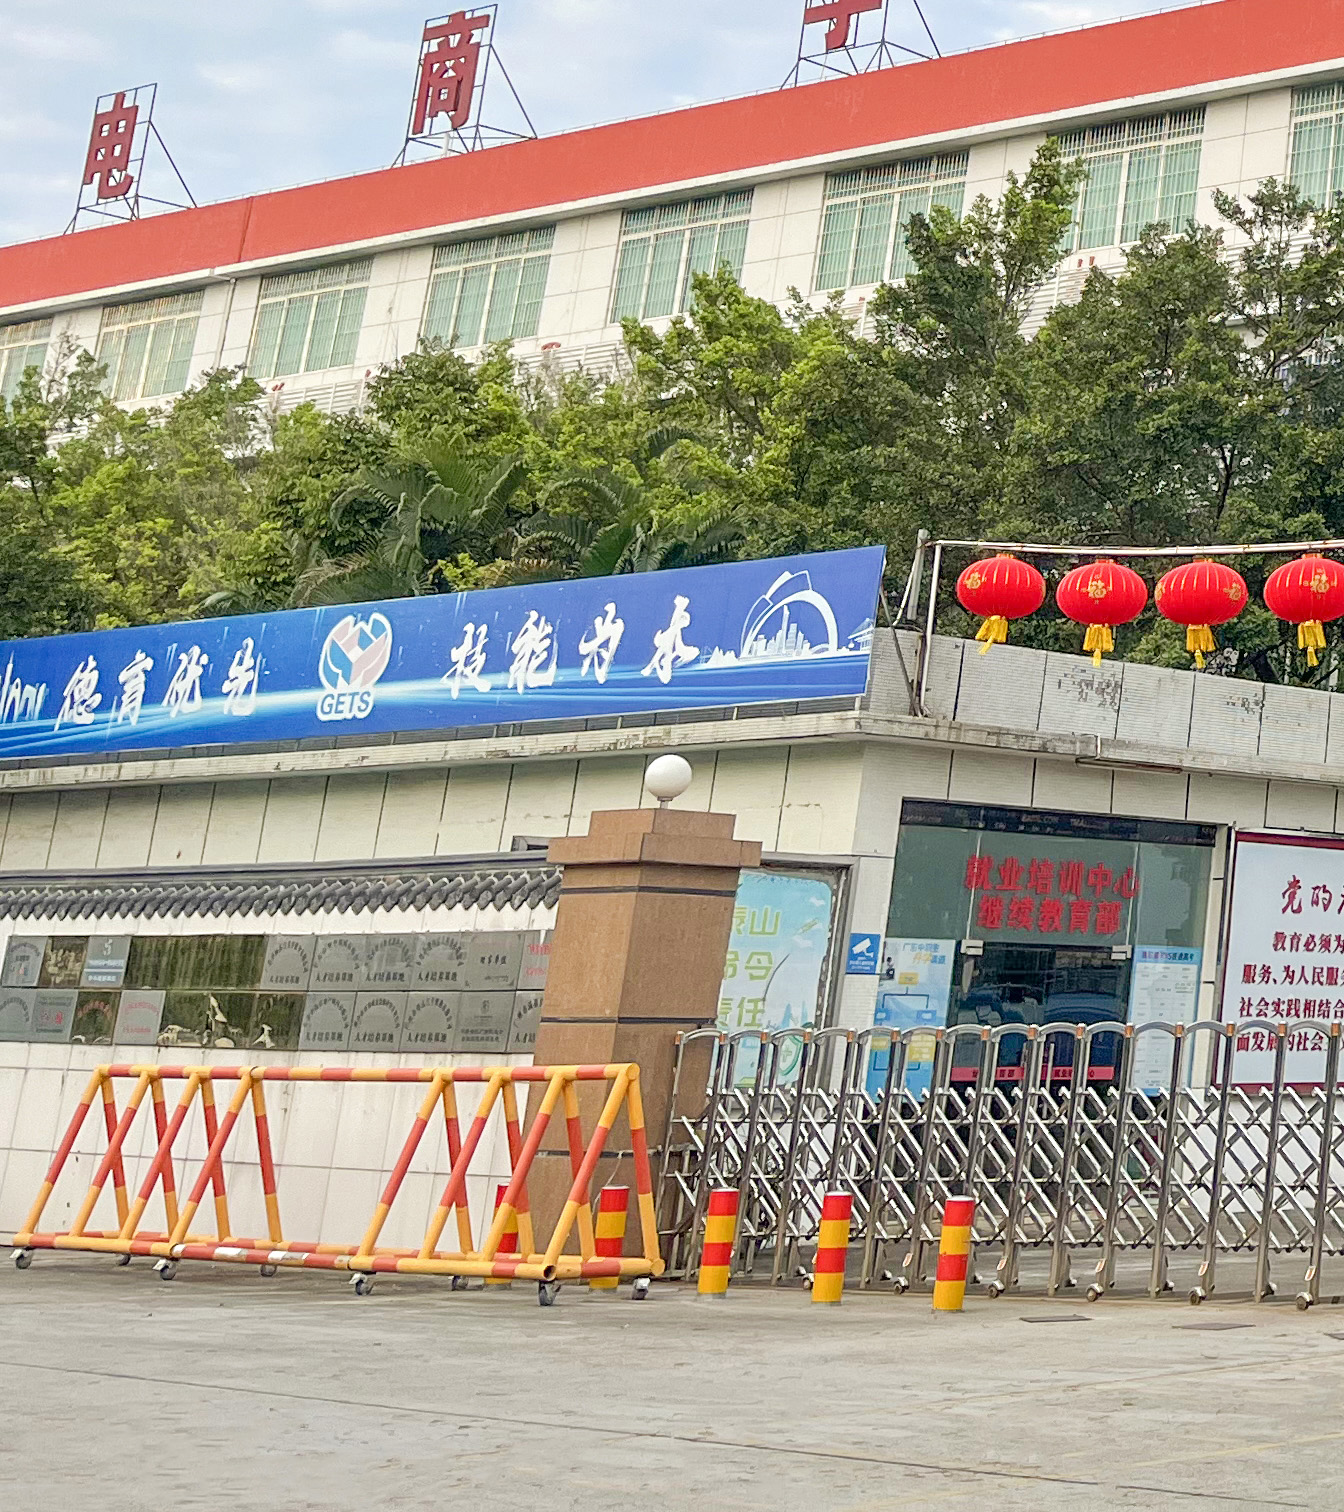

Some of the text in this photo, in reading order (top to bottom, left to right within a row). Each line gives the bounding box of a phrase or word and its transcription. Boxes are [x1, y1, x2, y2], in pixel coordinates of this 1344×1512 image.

[319, 689, 373, 718] GETS
[965, 854, 1141, 899] 就业培训中心
[977, 893, 1122, 935] 继续教育部
